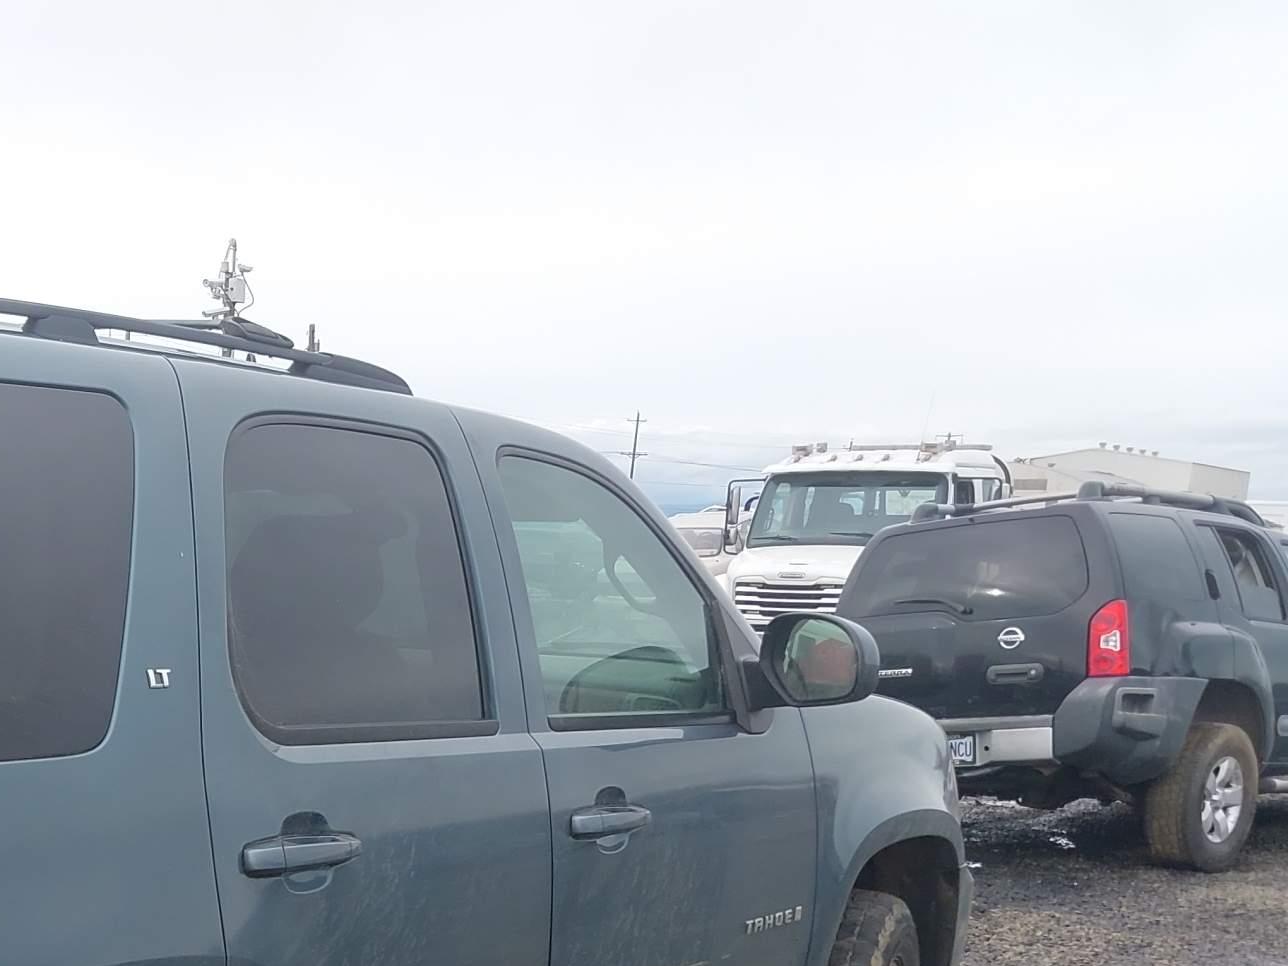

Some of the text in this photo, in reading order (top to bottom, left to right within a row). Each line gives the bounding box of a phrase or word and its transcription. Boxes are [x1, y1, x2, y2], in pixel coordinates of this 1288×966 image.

[145, 668, 171, 689] LT
[950, 741, 972, 757] NCU
[745, 908, 794, 936] TAHOE
